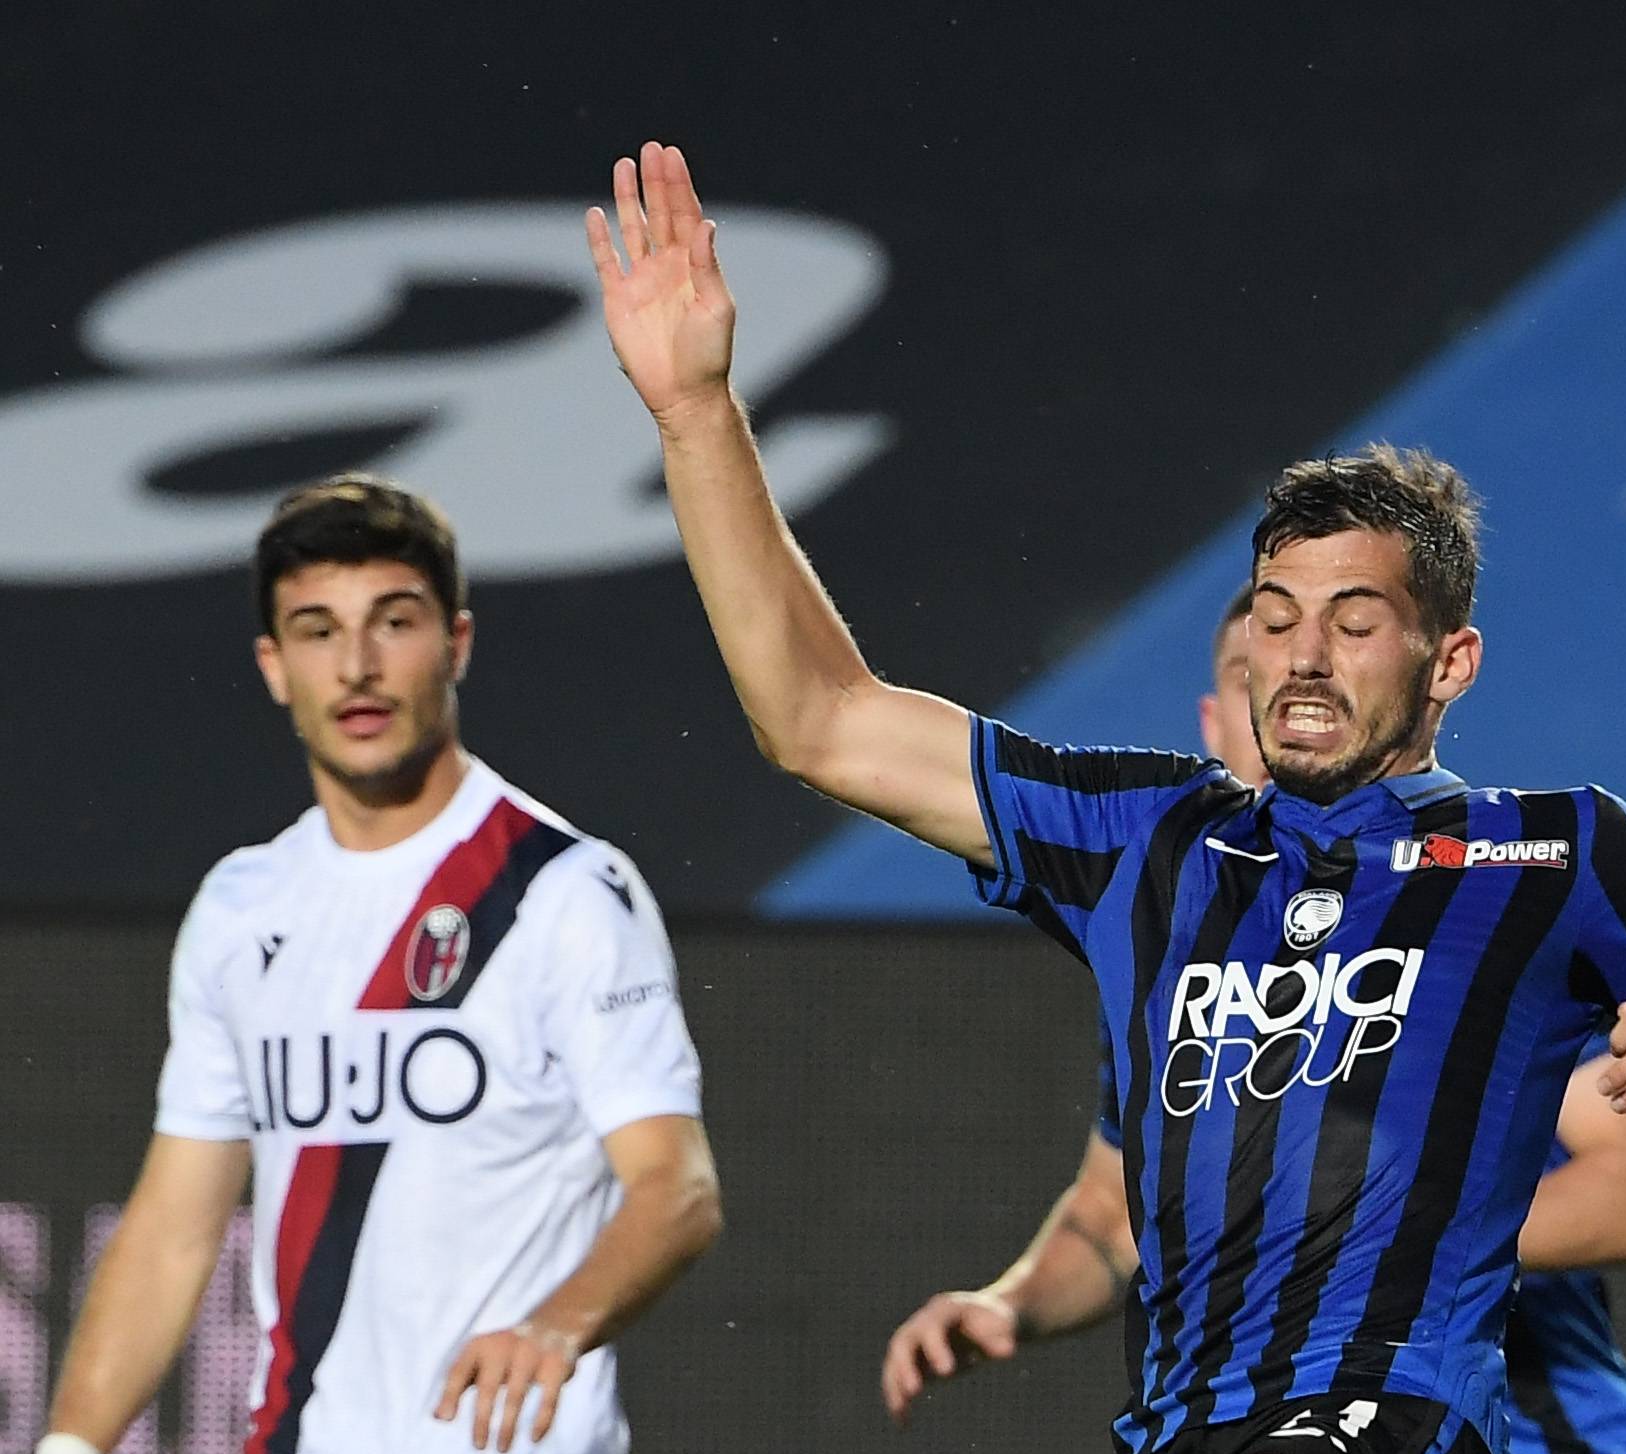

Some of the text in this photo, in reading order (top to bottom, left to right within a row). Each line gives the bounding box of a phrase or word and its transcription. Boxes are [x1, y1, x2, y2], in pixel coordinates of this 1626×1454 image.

[1464, 841, 1566, 867] Power
[1167, 947, 1425, 1042] RADICI
[1160, 1014, 1402, 1118] GROUP
